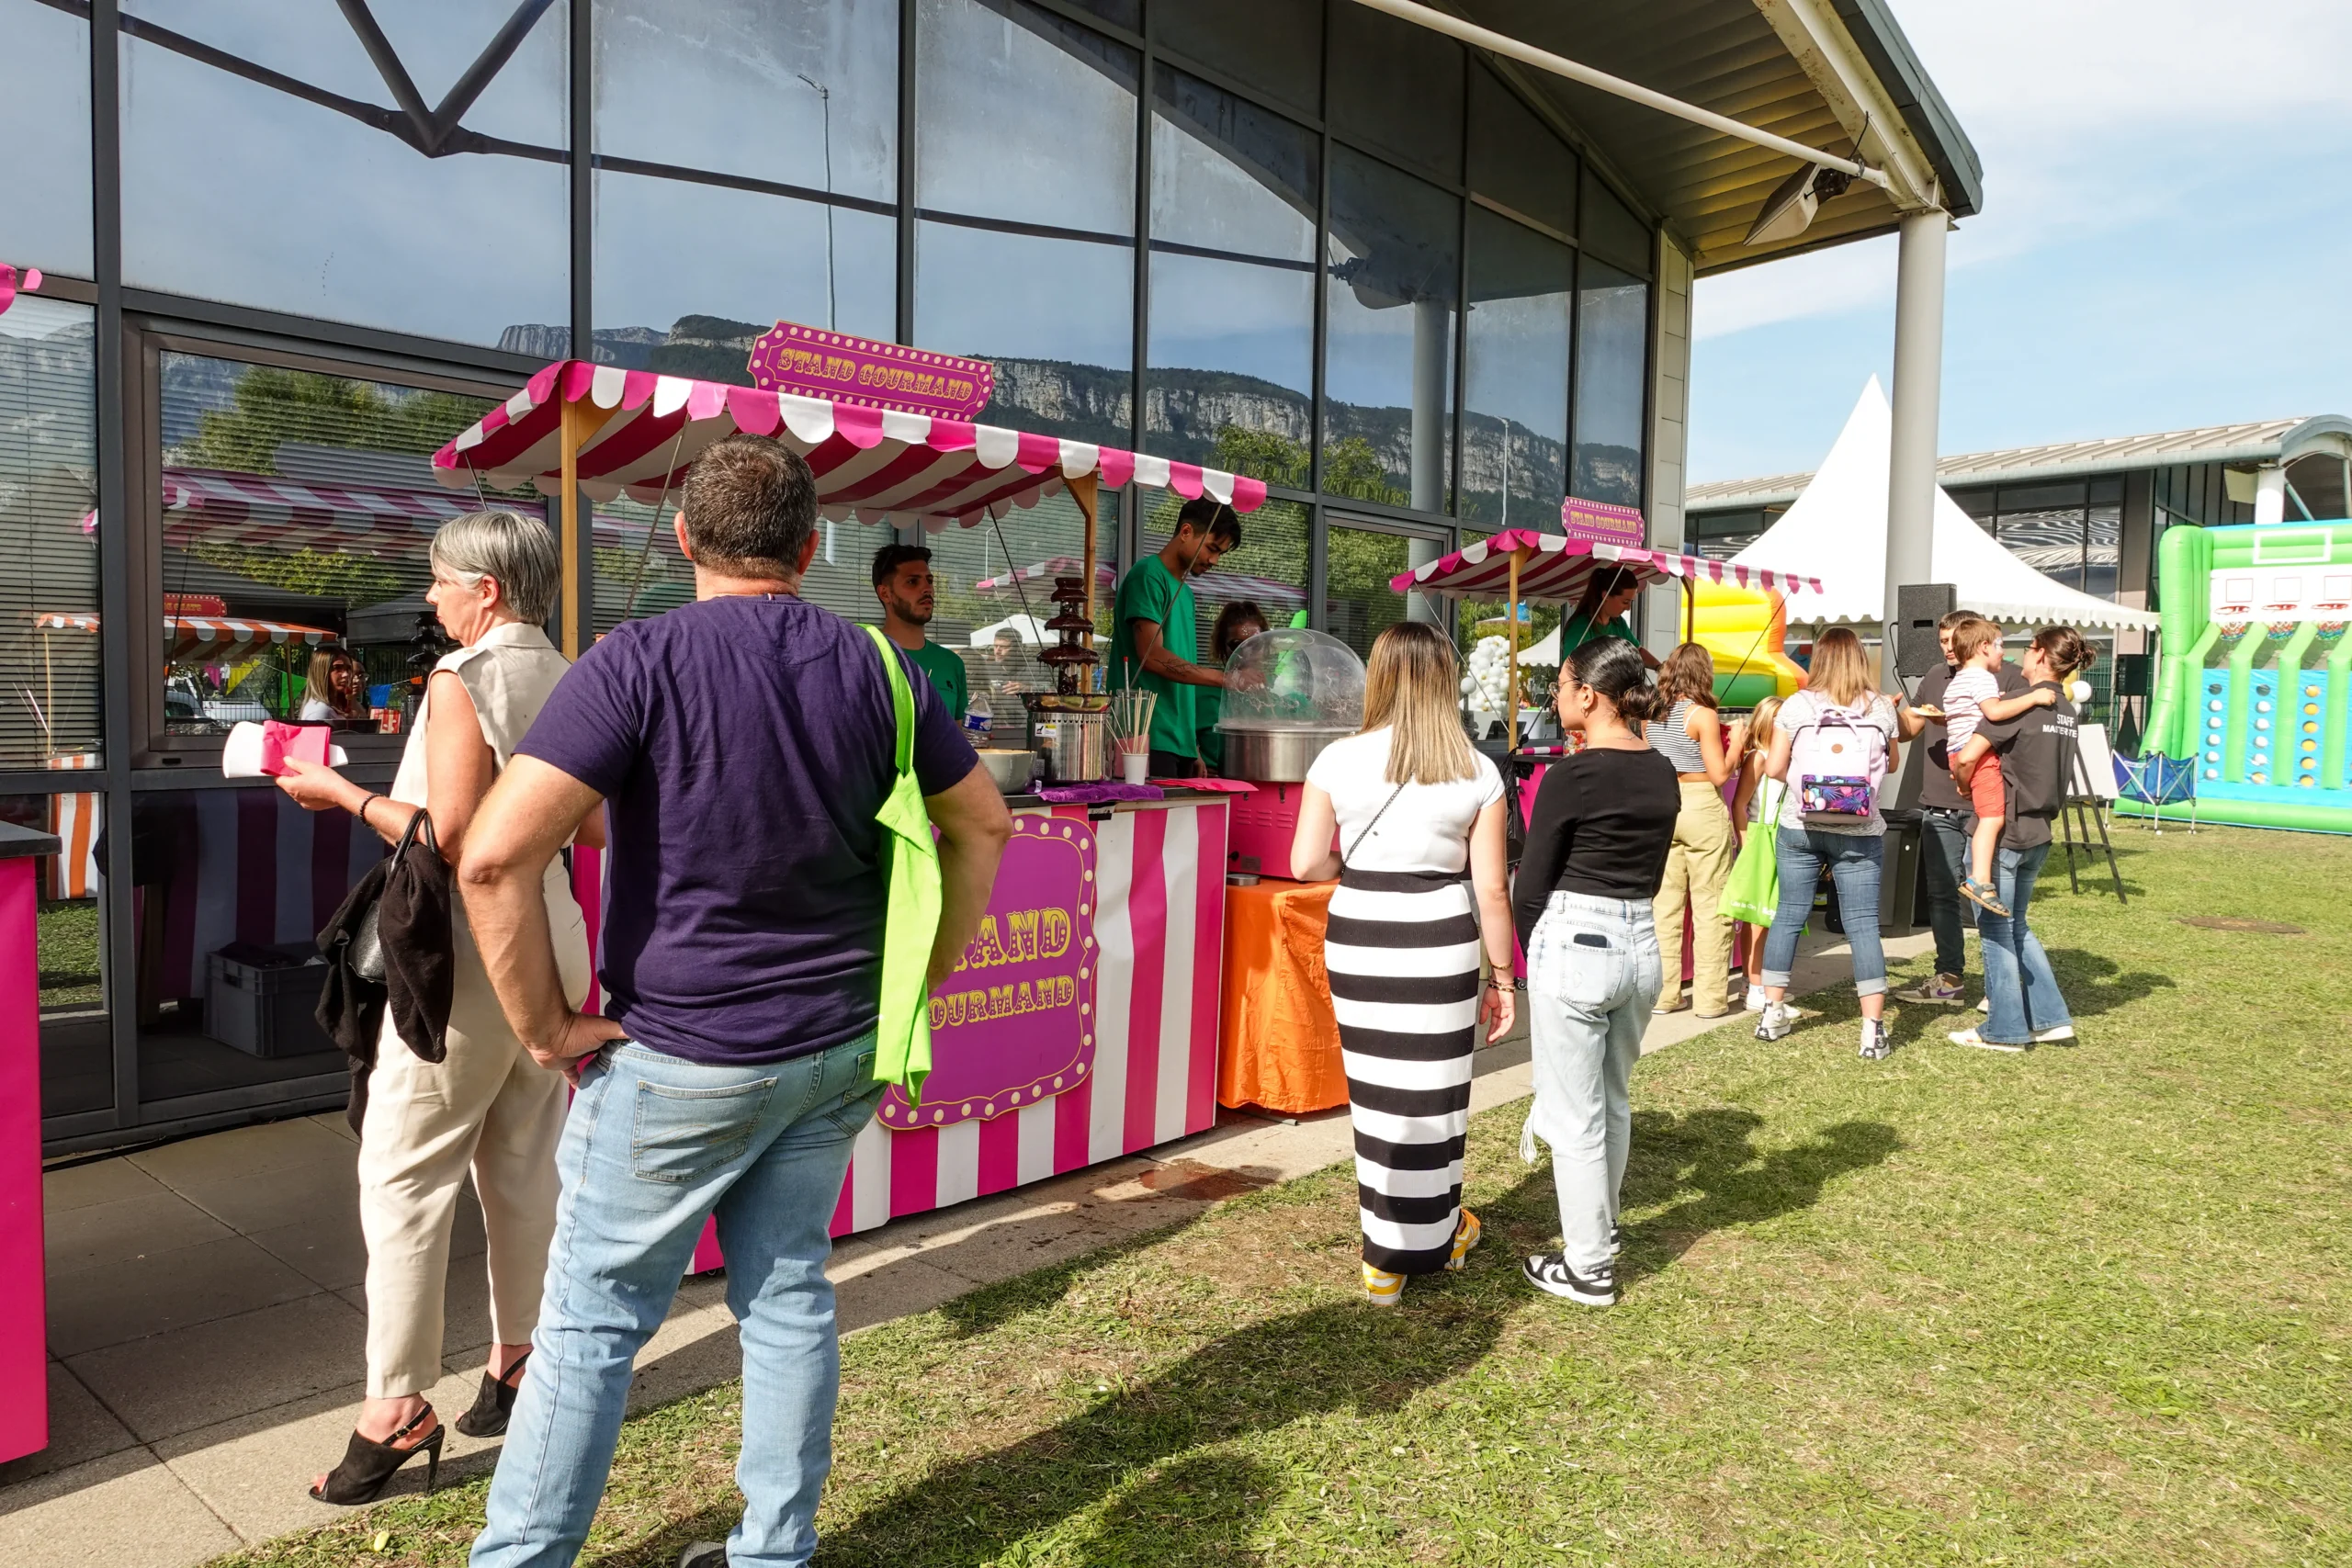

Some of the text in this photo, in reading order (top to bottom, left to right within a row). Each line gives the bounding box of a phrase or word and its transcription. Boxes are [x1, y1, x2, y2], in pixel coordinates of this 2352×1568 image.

[777, 348, 973, 401] STAND GOURMAND
[1570, 511, 1637, 534] STAND GOURMAND
[2056, 714, 2075, 728] STAFF
[954, 907, 1071, 973] AND
[928, 975, 1075, 1030] OURMAND
